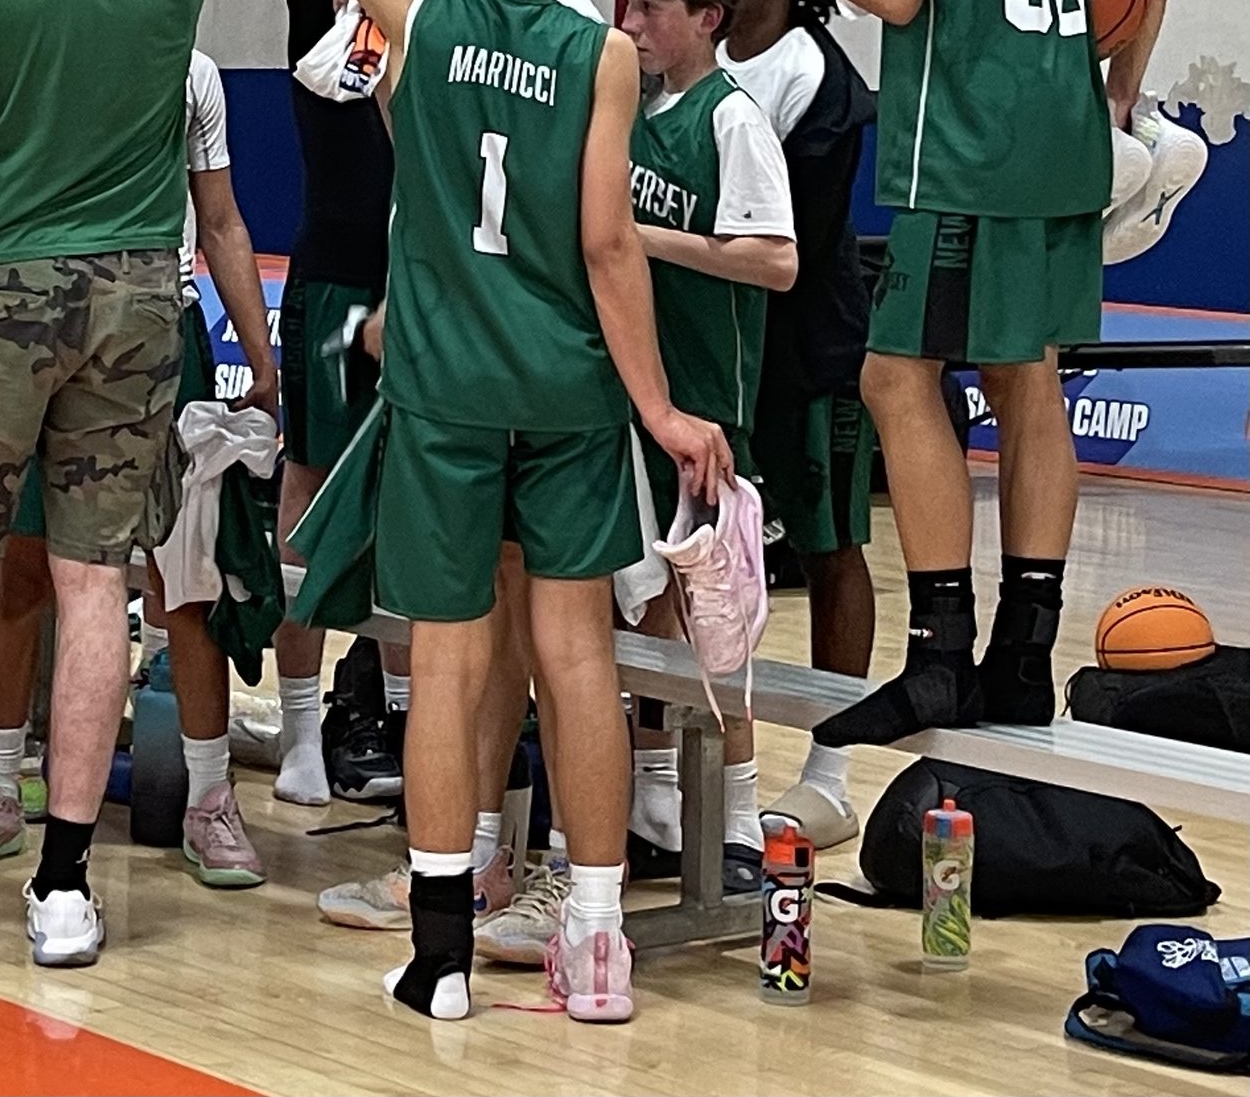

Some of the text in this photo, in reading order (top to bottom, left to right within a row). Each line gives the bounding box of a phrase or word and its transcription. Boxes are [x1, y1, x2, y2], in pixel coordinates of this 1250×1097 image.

[473, 132, 508, 255] 1
[629, 160, 698, 231] ERSEY
[1072, 398, 1149, 442] CAMP
[770, 889, 800, 924] G
